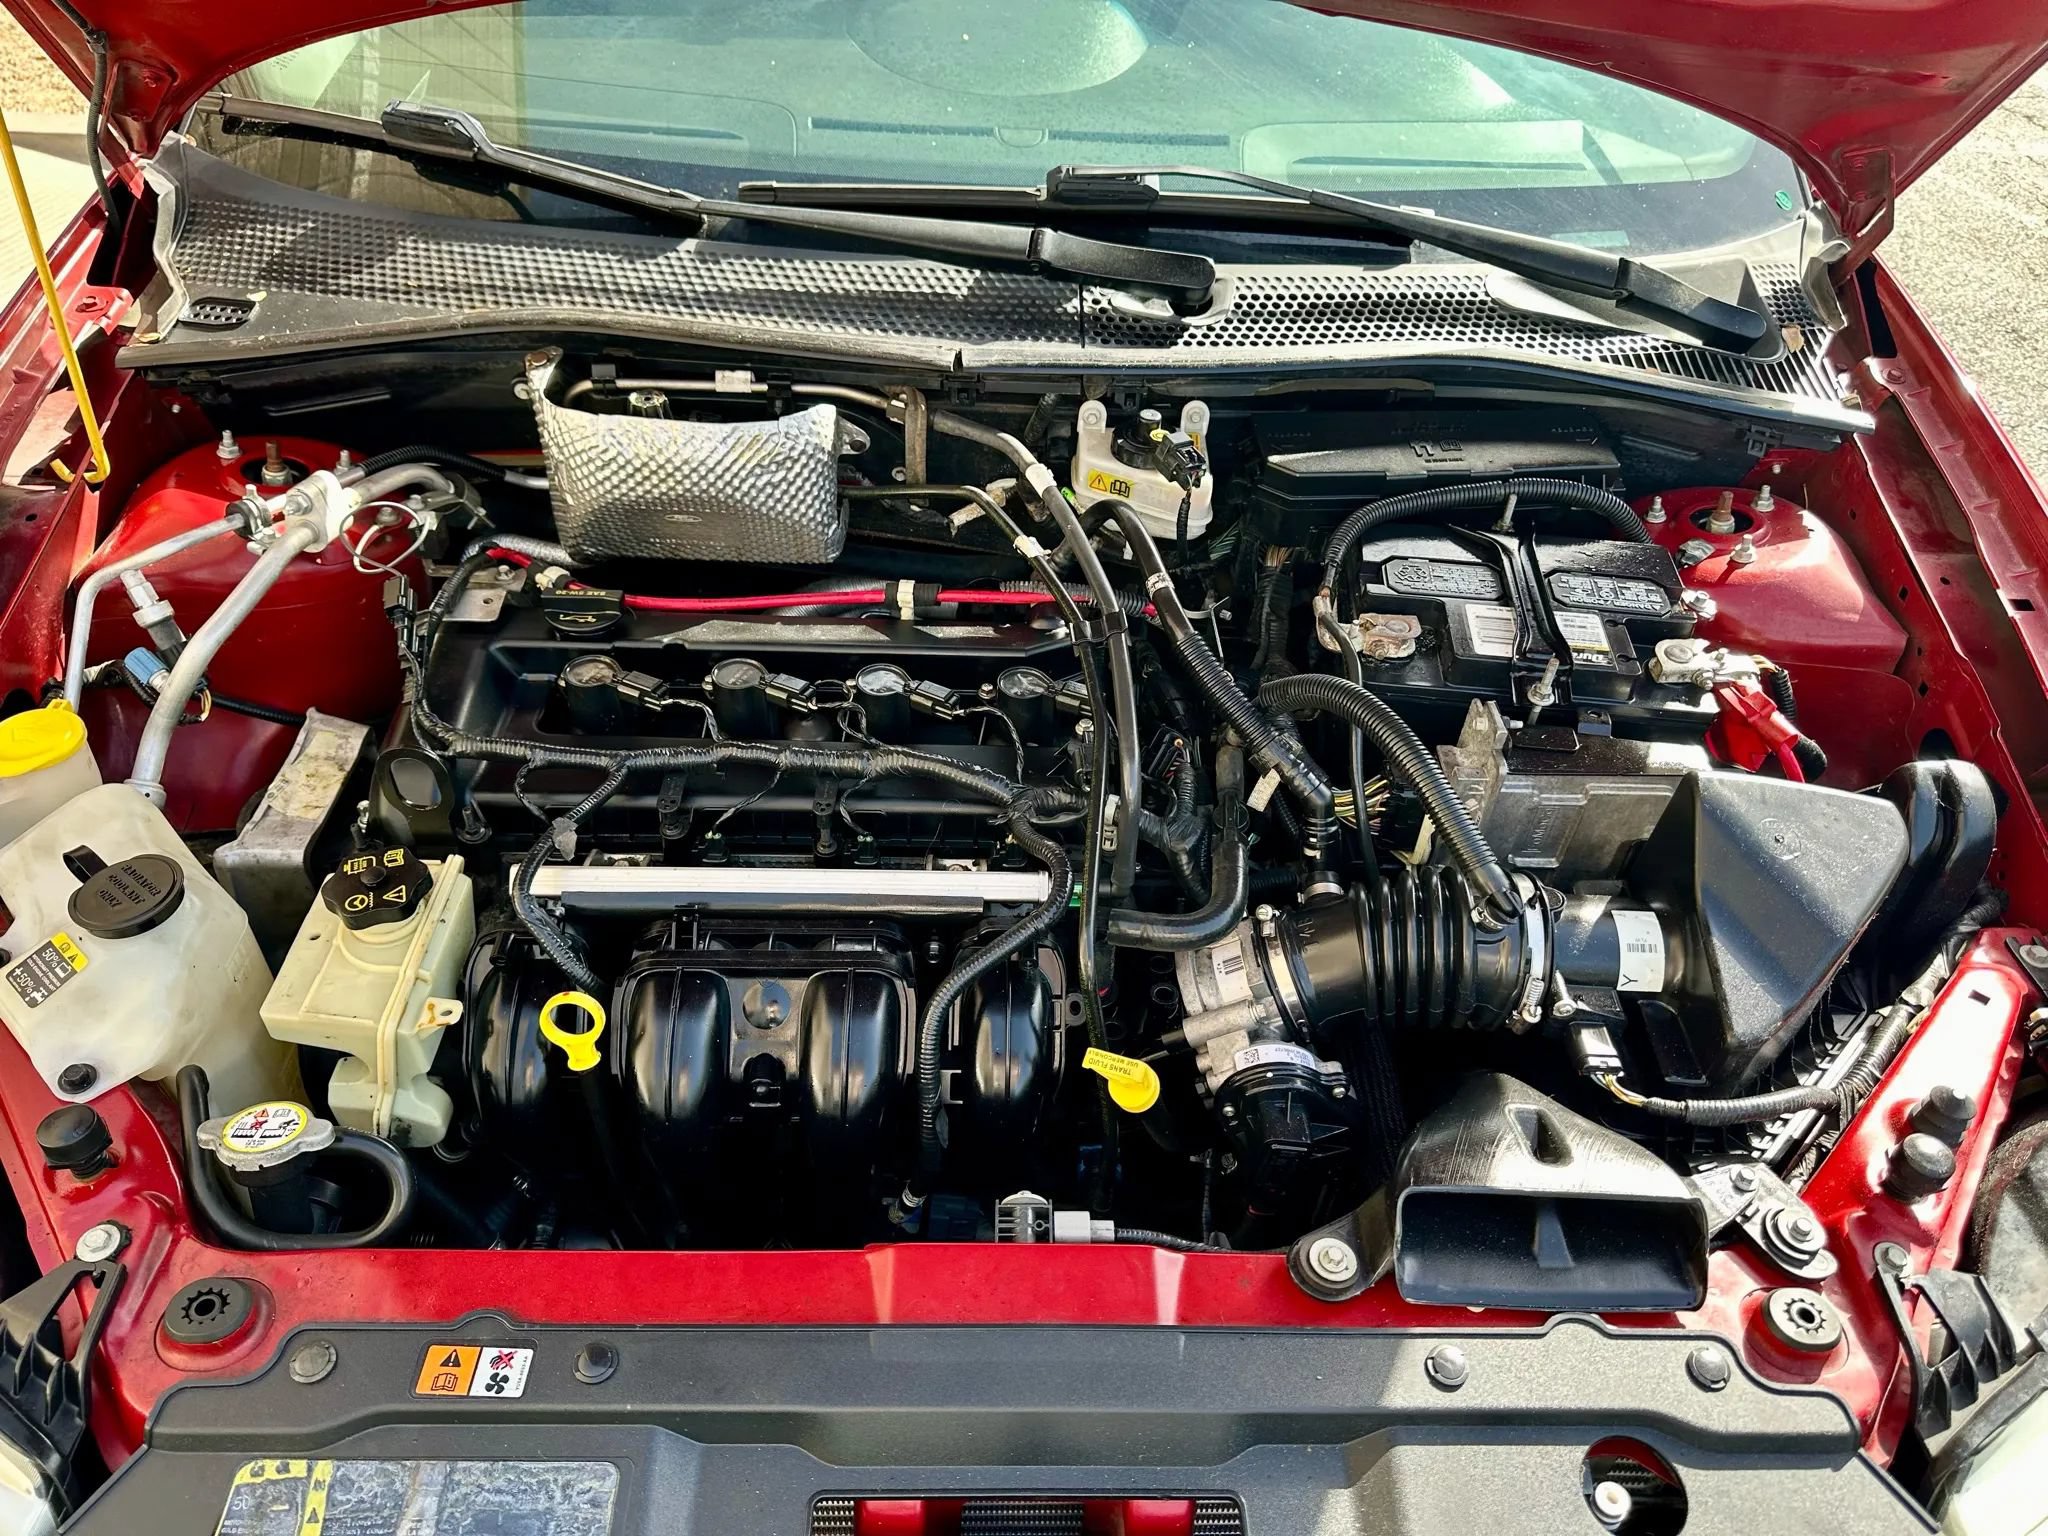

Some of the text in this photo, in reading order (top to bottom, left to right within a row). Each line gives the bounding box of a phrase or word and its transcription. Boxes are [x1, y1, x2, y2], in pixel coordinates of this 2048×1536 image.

[108, 874, 146, 905] COOLANT
[121, 865, 162, 897] RADIATOR
[99, 889, 122, 908] ONLY
[42, 947, 60, 968] 50%
[1088, 1057, 1131, 1076] TRANS FLUID
[1127, 1060, 1139, 1068] USE
